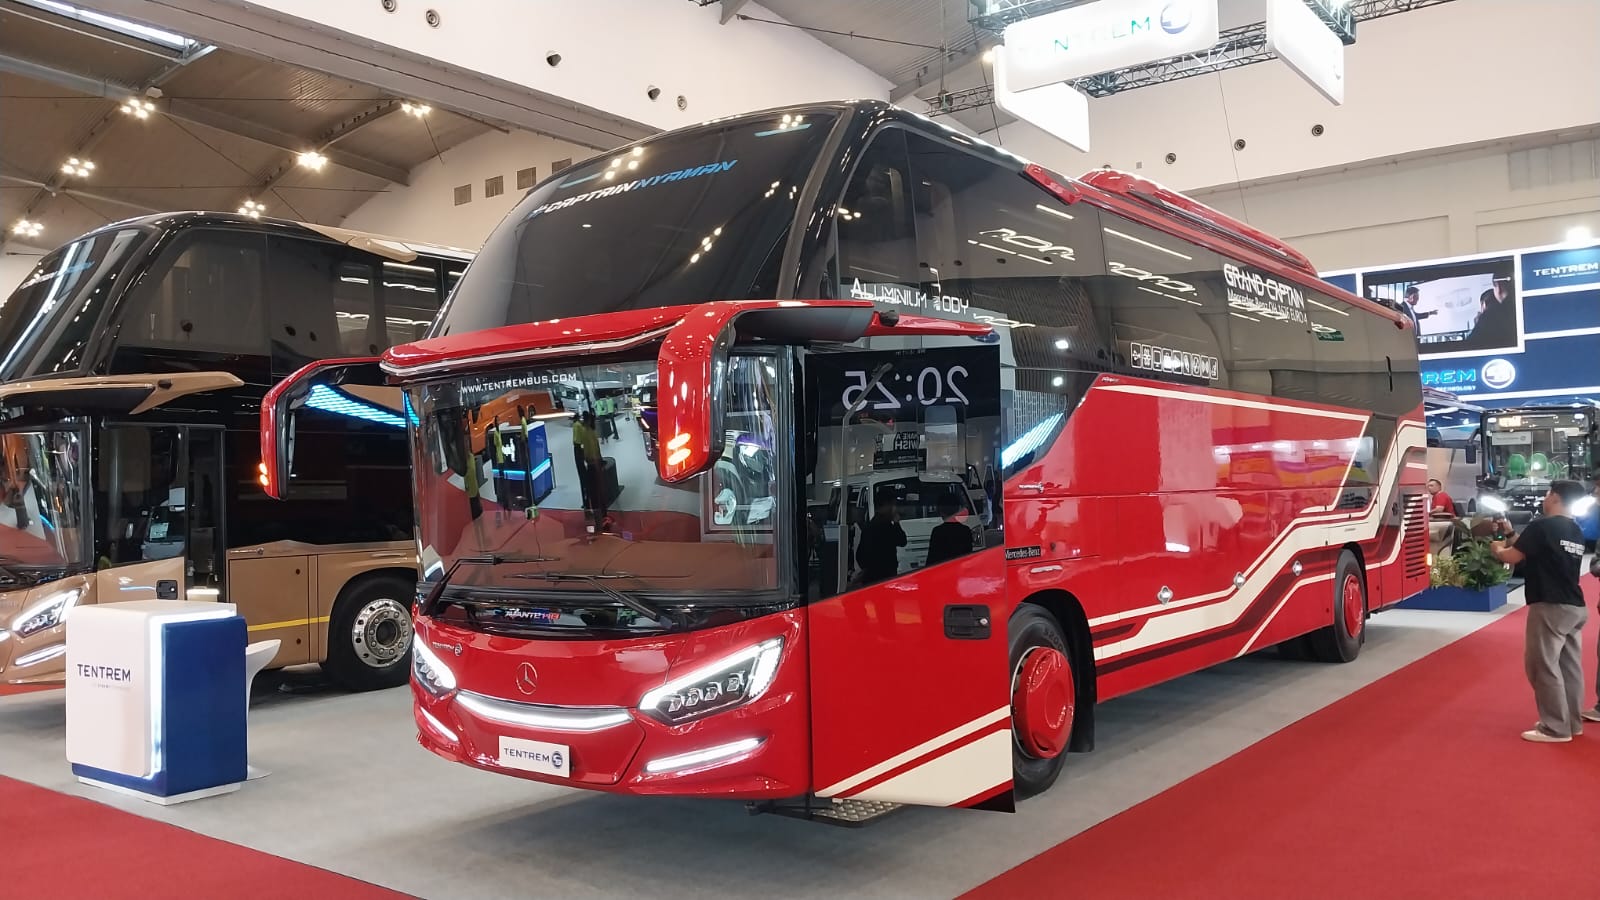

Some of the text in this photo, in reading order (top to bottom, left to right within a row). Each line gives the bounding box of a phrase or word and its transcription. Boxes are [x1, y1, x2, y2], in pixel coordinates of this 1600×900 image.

[1533, 262, 1599, 277] TENTREM
[1224, 263, 1264, 297] GRAND
[850, 277, 927, 309] ALUMINIUM
[460, 372, 577, 394] WWW.TENTREMBUS.COM
[1420, 367, 1477, 385] REM
[77, 663, 131, 682] TENTREM
[504, 747, 550, 762] TENTREM
